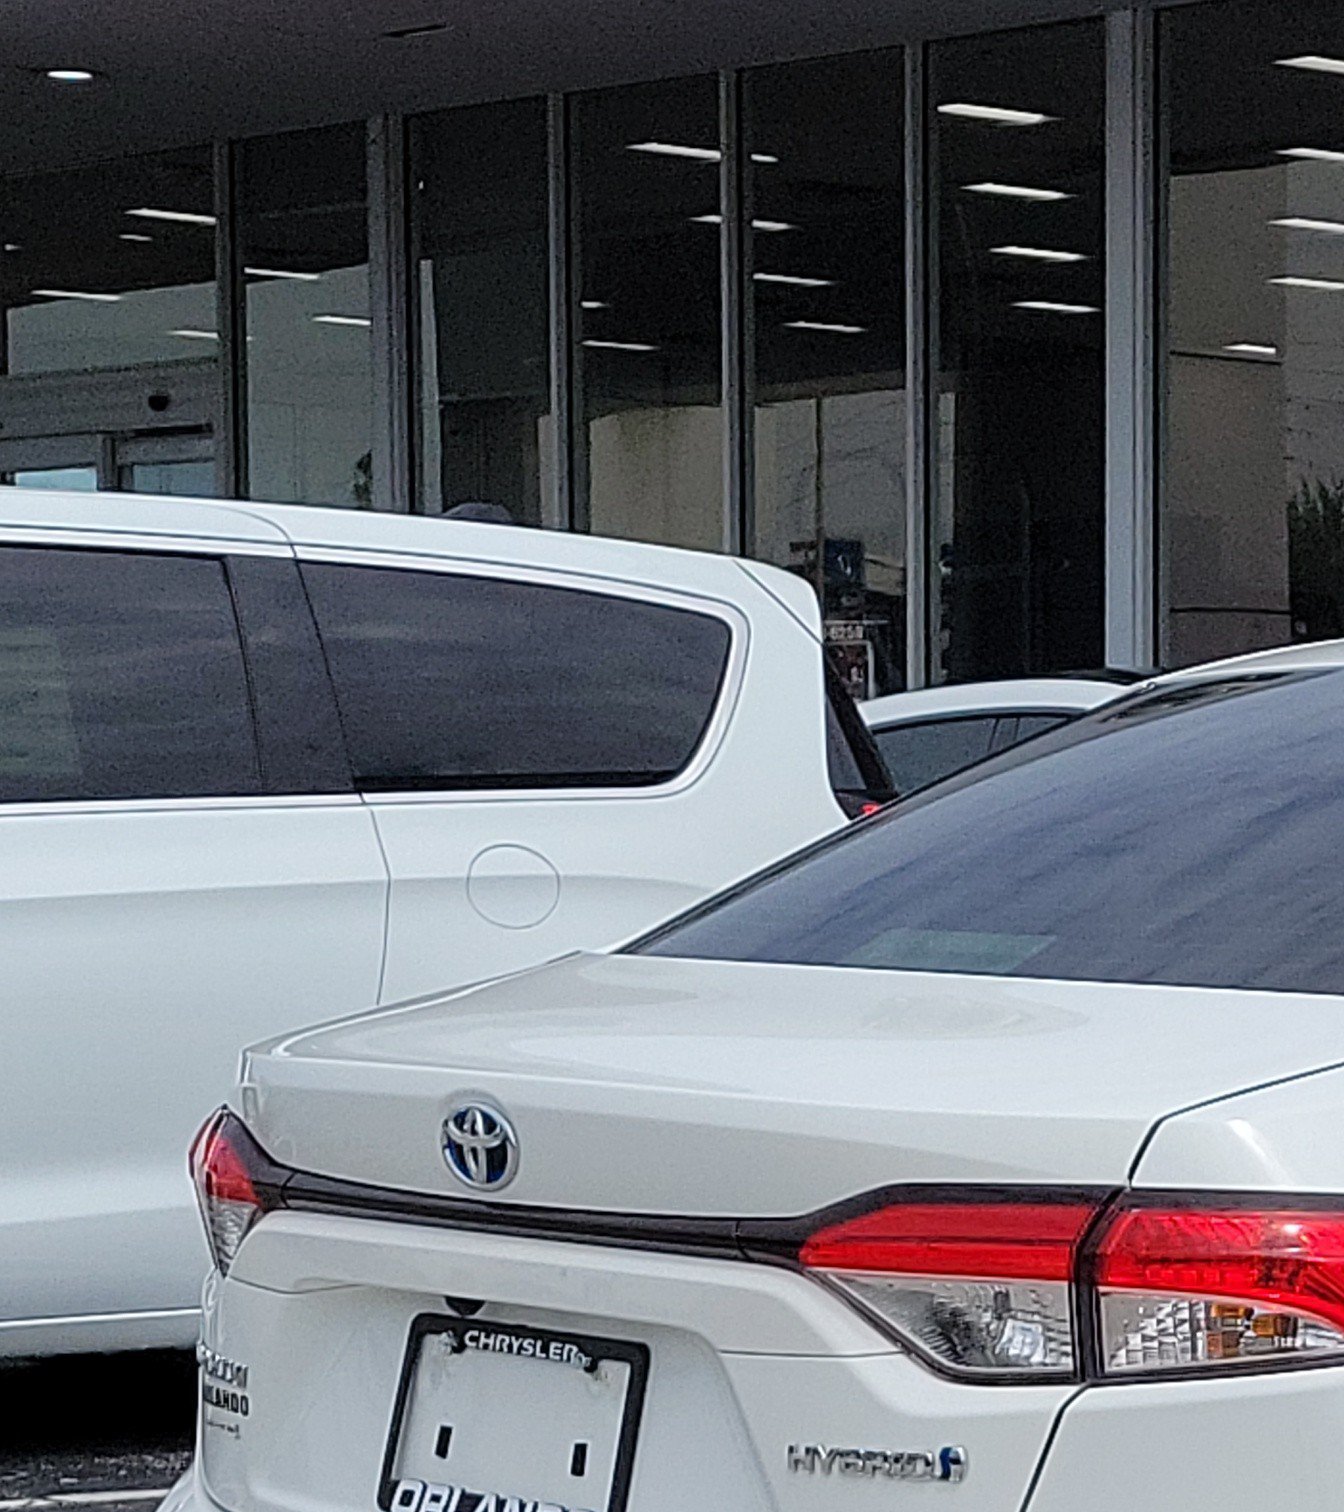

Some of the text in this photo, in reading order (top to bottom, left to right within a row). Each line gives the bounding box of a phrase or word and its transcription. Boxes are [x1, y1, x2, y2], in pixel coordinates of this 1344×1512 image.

[464, 1329, 579, 1366] CHRYSLER
[203, 1385, 250, 1417] LANDO
[787, 1444, 935, 1481] HYBRID
